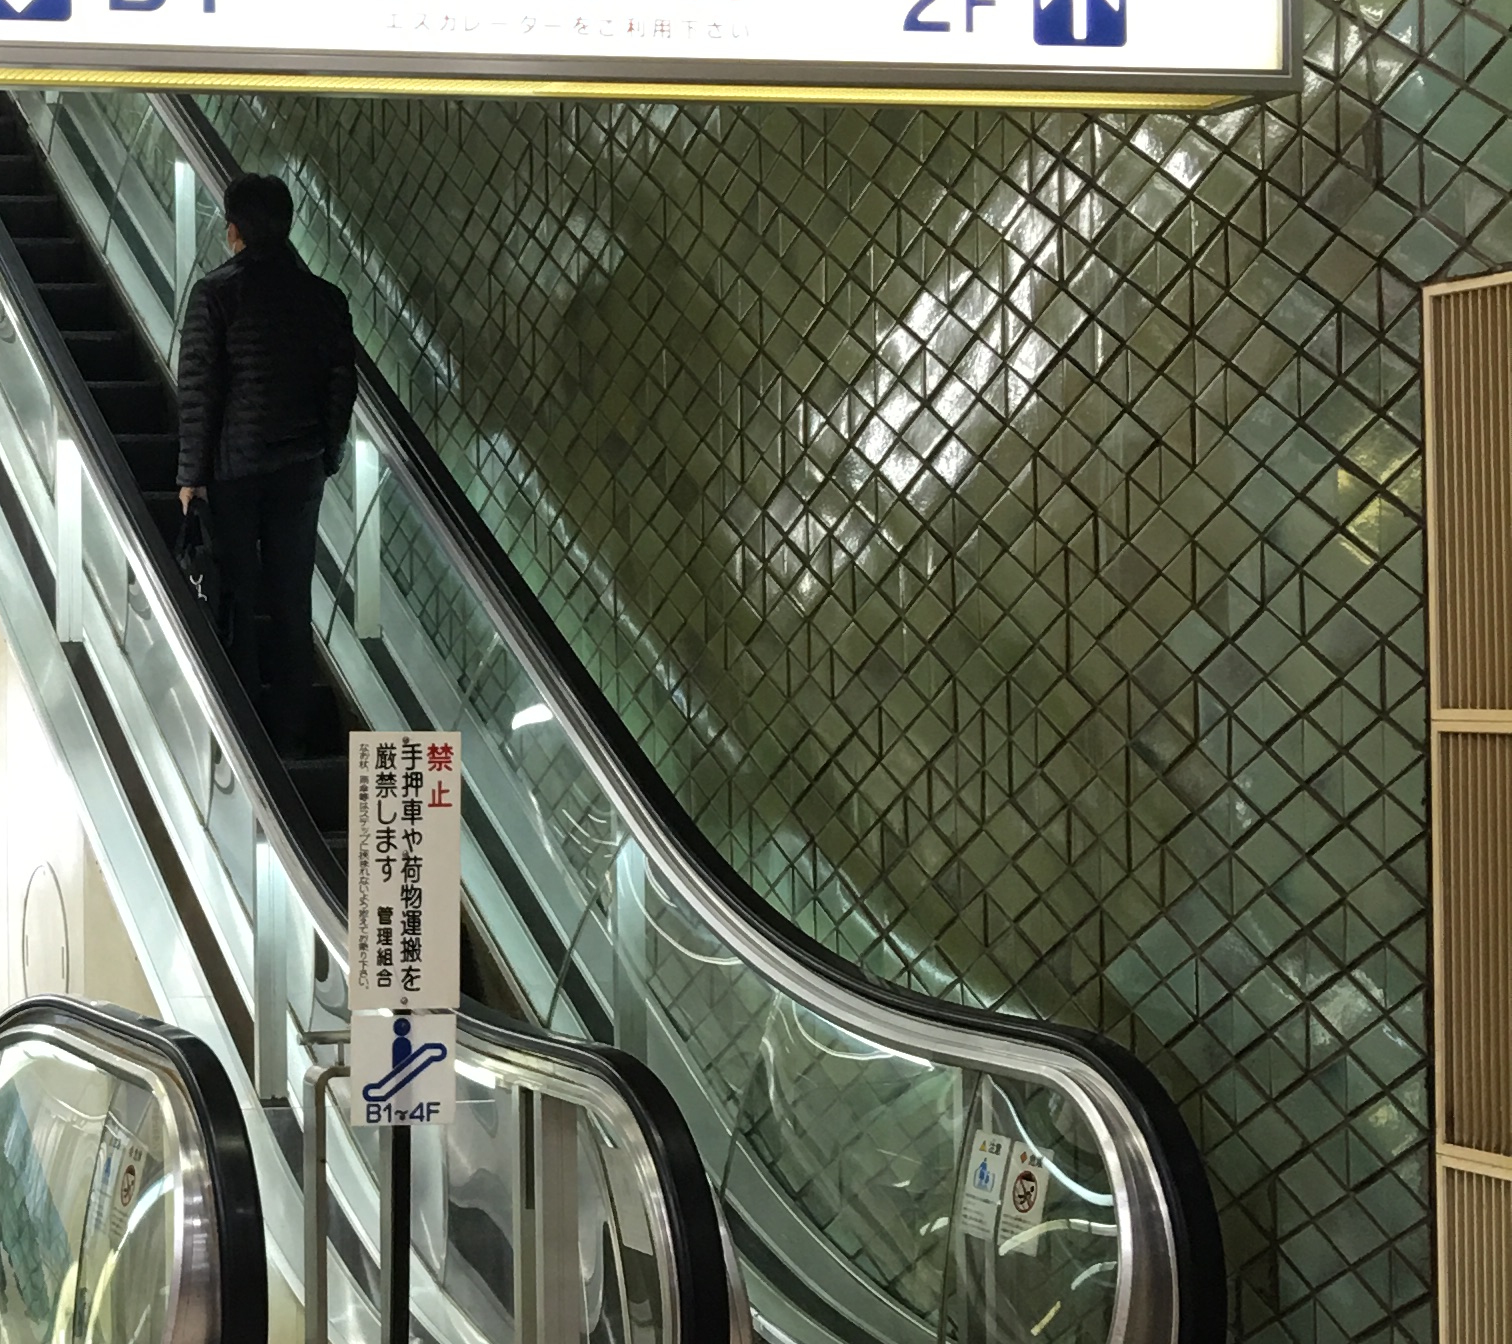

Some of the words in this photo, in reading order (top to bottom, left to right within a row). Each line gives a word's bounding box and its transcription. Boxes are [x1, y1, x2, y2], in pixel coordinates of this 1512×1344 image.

[374, 742, 398, 884] 厳禁します
[426, 742, 454, 809] 禁止
[399, 743, 424, 993] 手押車や荷物運搬を
[376, 906, 394, 989] 管理組合
